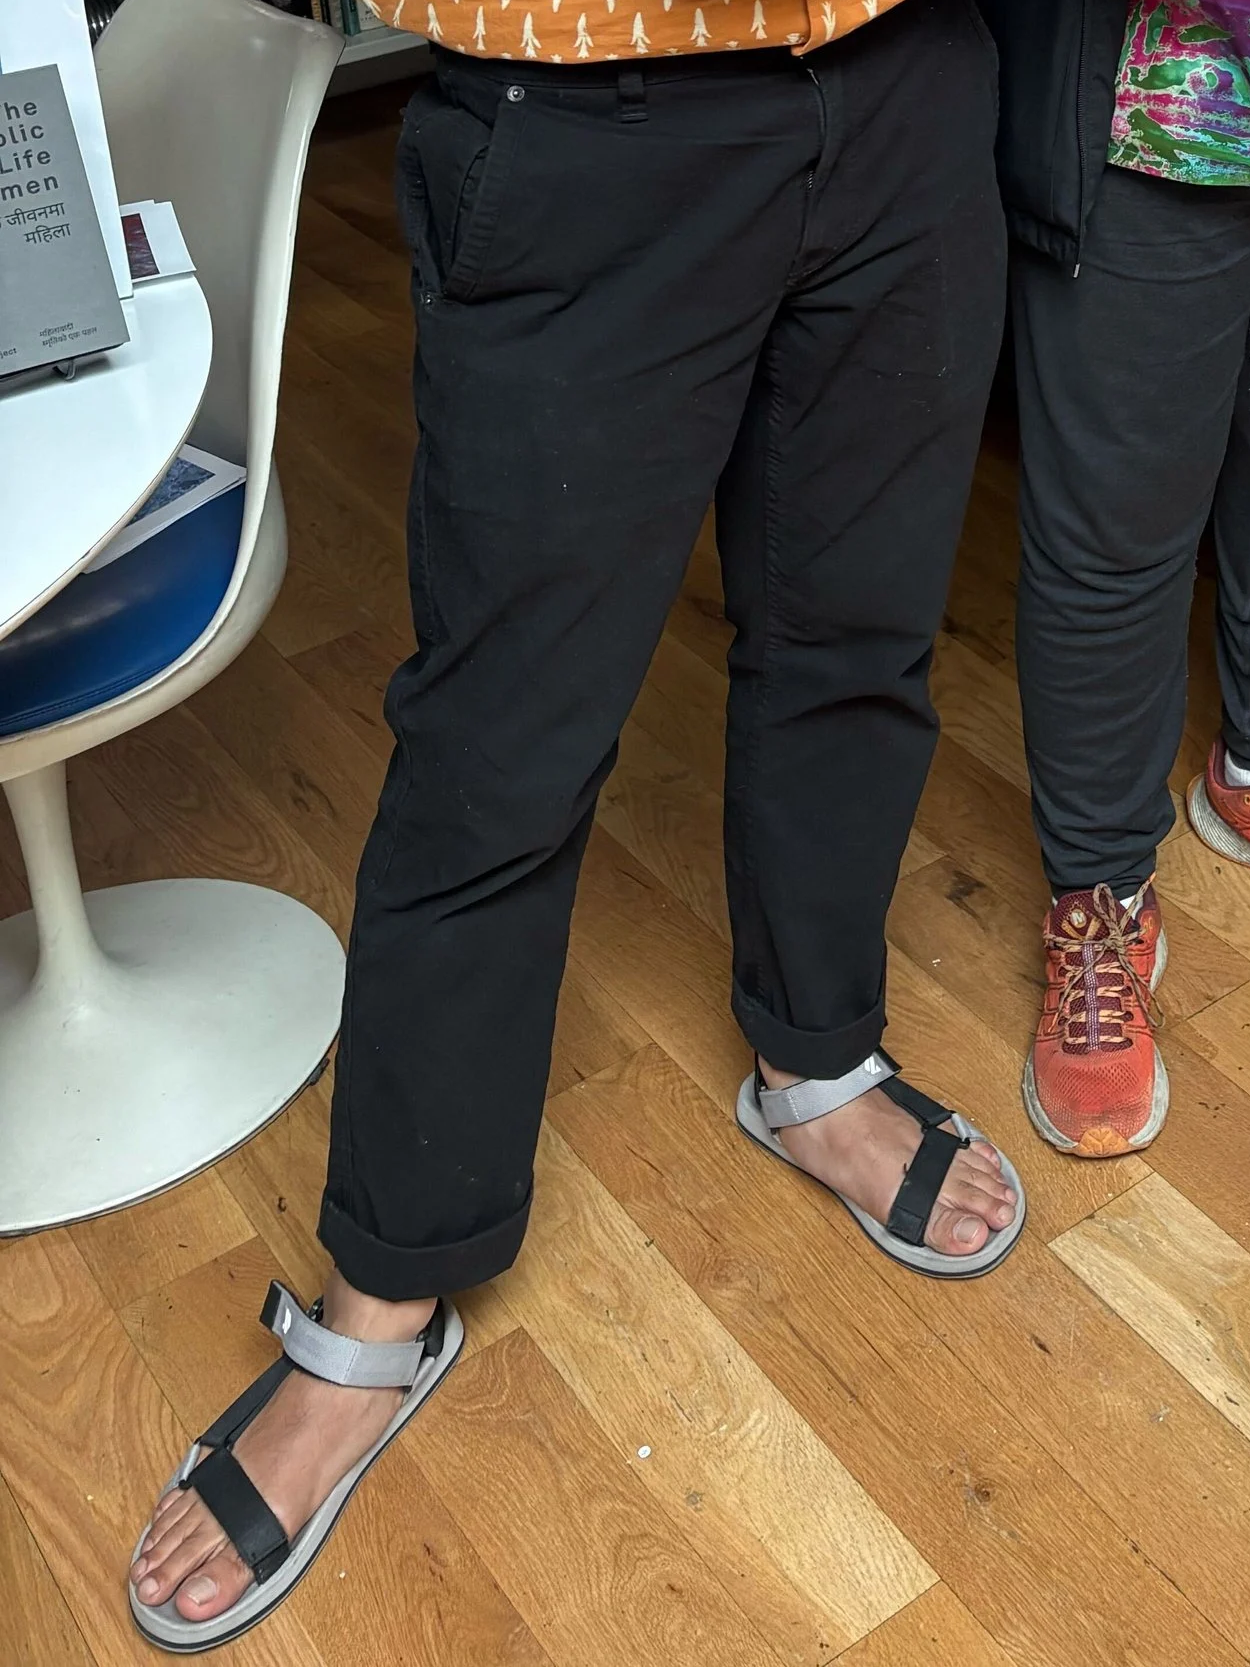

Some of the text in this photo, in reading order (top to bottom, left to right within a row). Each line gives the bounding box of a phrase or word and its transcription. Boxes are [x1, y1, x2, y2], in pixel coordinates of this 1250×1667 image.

[0, 149, 51, 174] Life
[5, 202, 65, 226] जीवनमा
[24, 223, 71, 244] महिला
